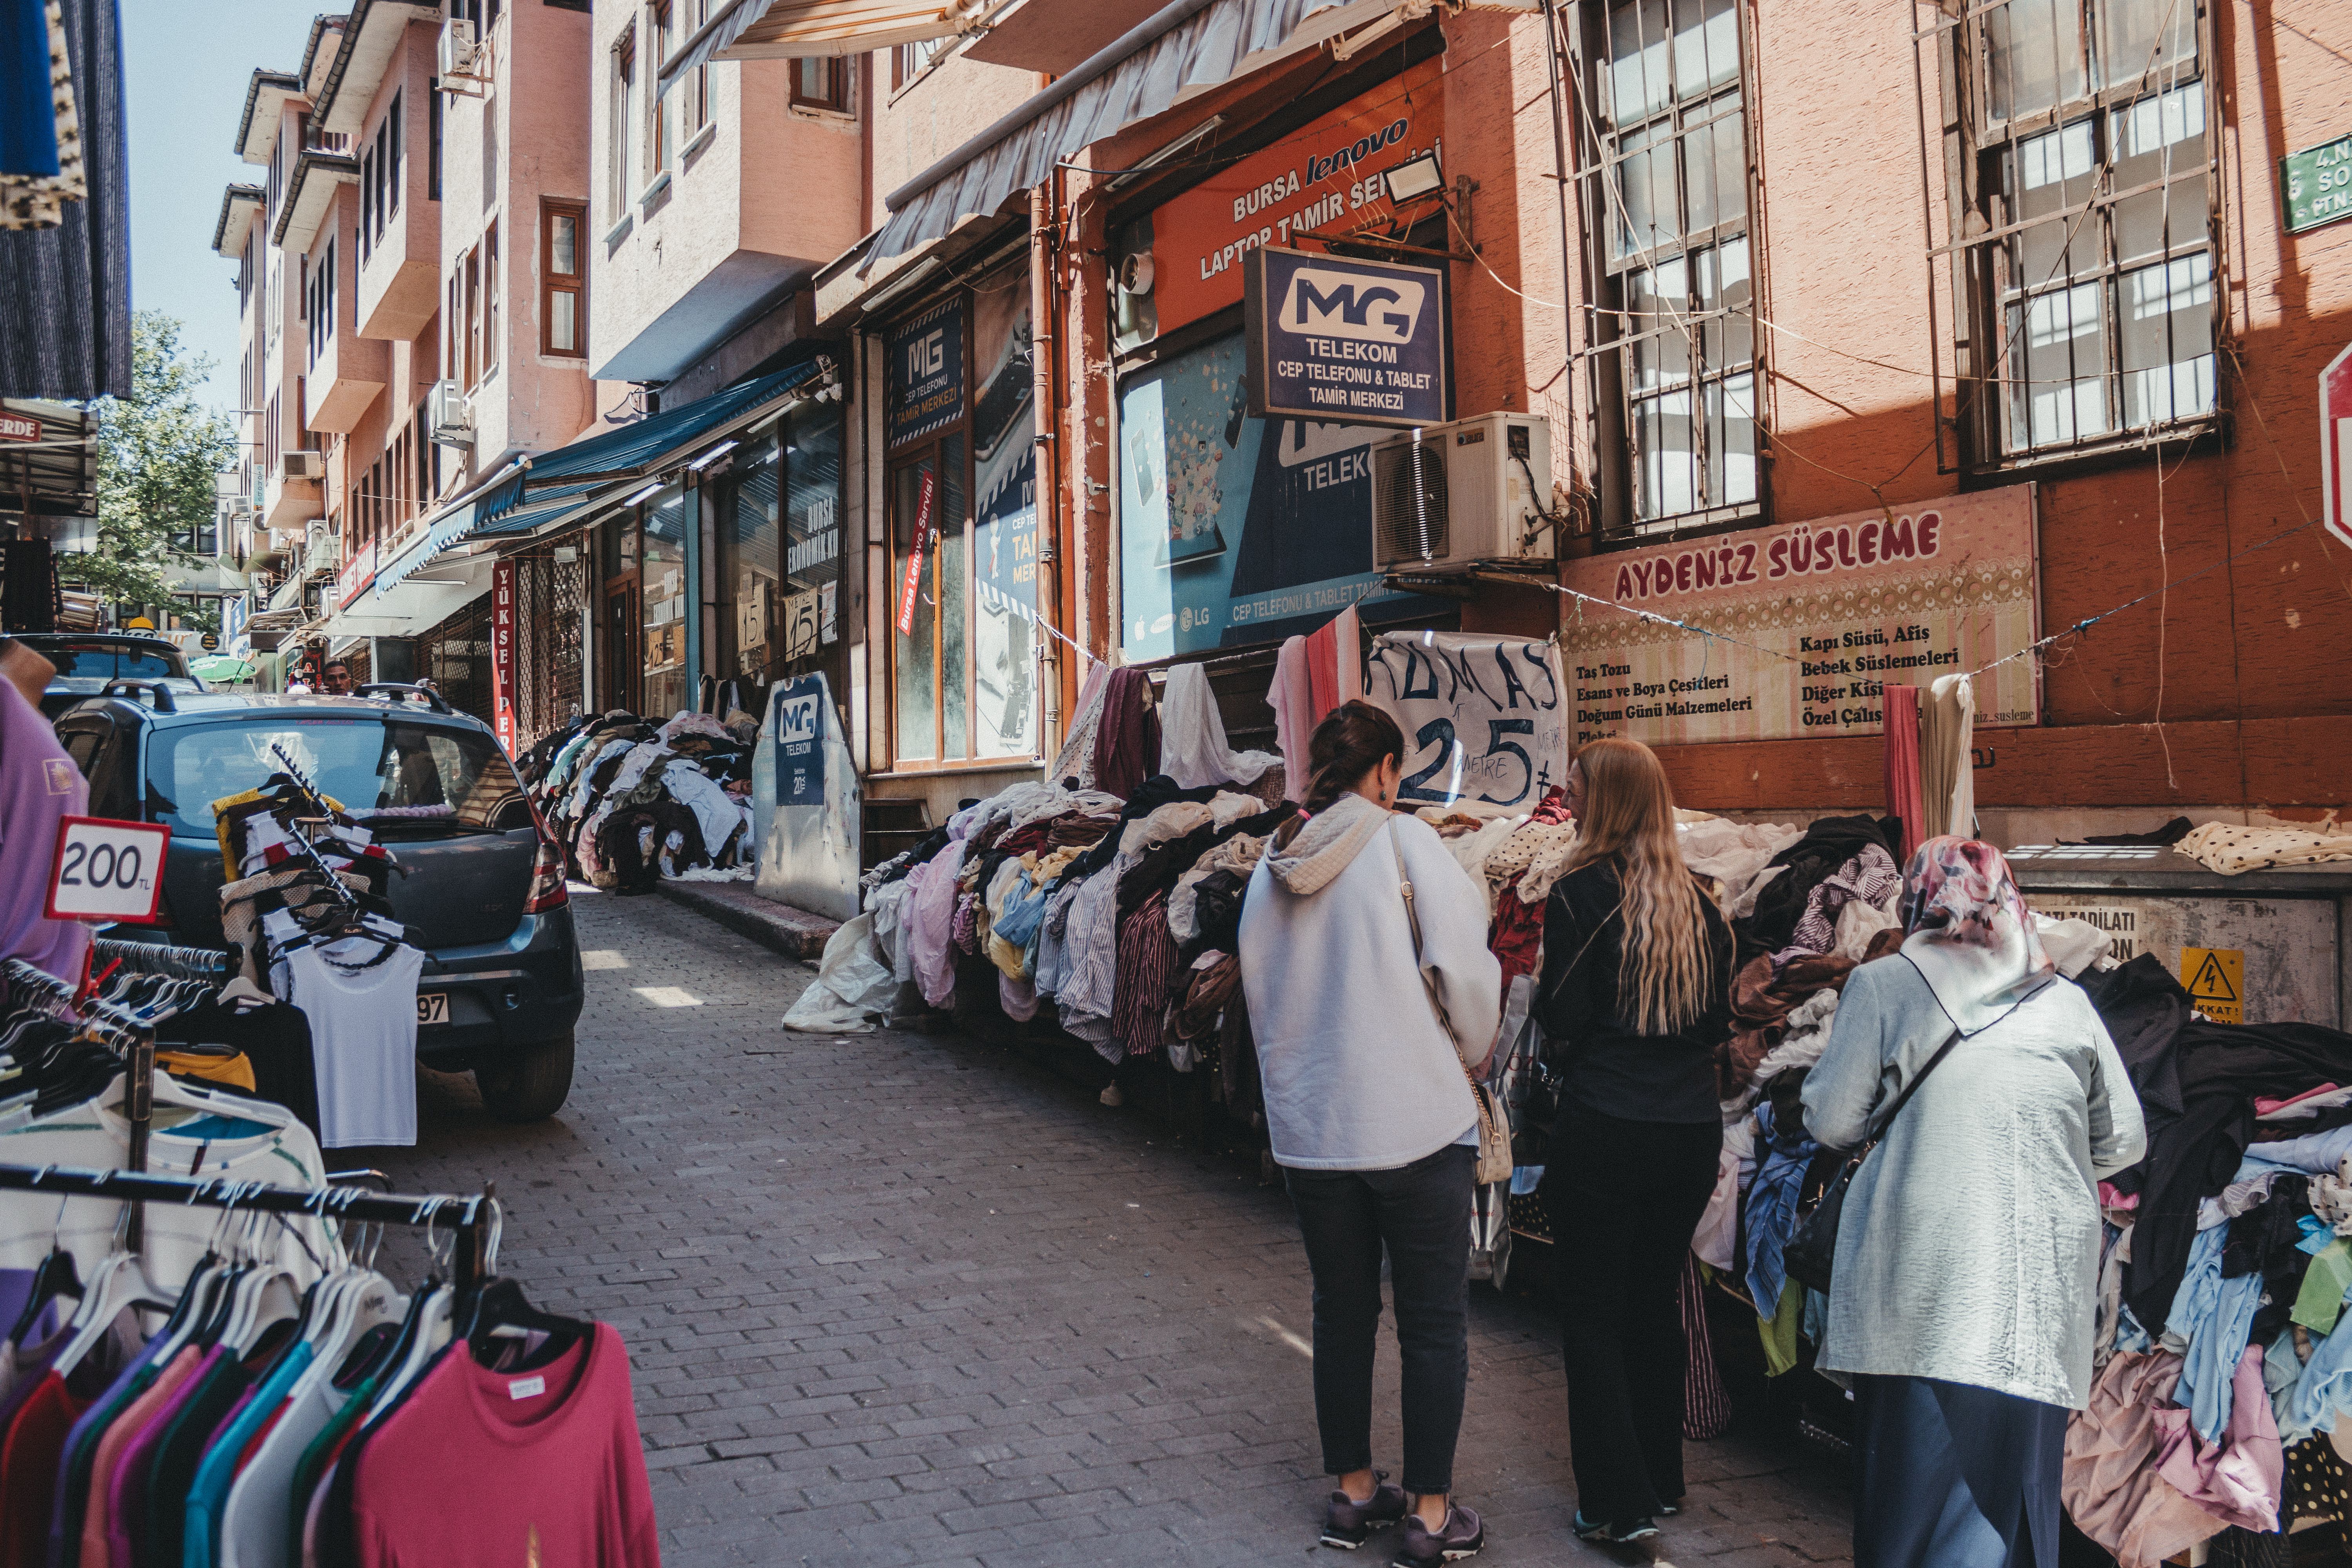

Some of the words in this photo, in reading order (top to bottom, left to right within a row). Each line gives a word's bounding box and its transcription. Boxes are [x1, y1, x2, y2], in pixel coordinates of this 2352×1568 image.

[1234, 169, 1301, 223] BURSA
[1305, 118, 1409, 187] lenovo
[1277, 192, 1345, 243] TAMİR
[1296, 278, 1410, 338] MG
[908, 328, 943, 385] MG
[1306, 338, 1397, 364] TELEKOM
[917, 374, 947, 397] TELEFONU
[1278, 361, 1303, 377] CEP
[1307, 363, 1372, 384] TELEFONU
[1375, 370, 1383, 385] &
[1387, 371, 1431, 389] TABLET
[922, 382, 957, 416] MERKEZİ
[1309, 385, 1347, 405] TAMİR
[1351, 391, 1404, 410] MERKEZİ
[1304, 452, 1372, 492] TELEK
[808, 496, 834, 534] BURSA
[1013, 516, 1025, 530] CEP
[788, 530, 827, 575] EKONOMİK
[901, 589, 914, 631] Bursa
[909, 532, 923, 583] Lenovo
[918, 478, 933, 529] Servisi
[1615, 538, 1758, 601] AYDENİZ
[1769, 512, 1940, 578] SÜSLEME
[1195, 607, 1209, 626] LG
[1233, 603, 1251, 622] CEP
[1253, 595, 1302, 618] TELEFONU
[1305, 592, 1312, 609] &
[1315, 585, 1354, 608] TABLET
[499, 569, 510, 685] YÜKSEL
[744, 604, 758, 646] 15
[790, 604, 813, 659] 15
[1800, 637, 1838, 653] Kapı
[1843, 629, 1889, 648] Süsü,
[1893, 625, 1930, 643] Afiş
[1576, 666, 1597, 680] Taş
[1600, 663, 1631, 677] Tozu
[1801, 659, 1851, 677] Bebek
[1855, 647, 1960, 672] Süslemeleri
[1577, 688, 1613, 701] Esans
[1615, 687, 1630, 697] ve
[1633, 682, 1665, 697] Boya
[1669, 674, 1730, 697] Çeşitleri
[1802, 684, 1846, 704] Diğer
[783, 702, 814, 737] MG
[1577, 708, 1622, 724] Doğum
[1626, 703, 1662, 719] Günü
[1666, 696, 1753, 716] Malzemeleri
[1802, 707, 1837, 726] Özel
[786, 742, 811, 756] TELEKOM
[1397, 717, 1534, 807] 25
[1456, 754, 1508, 779] METRE
[61, 842, 142, 889] 200
[139, 879, 151, 890] TL
